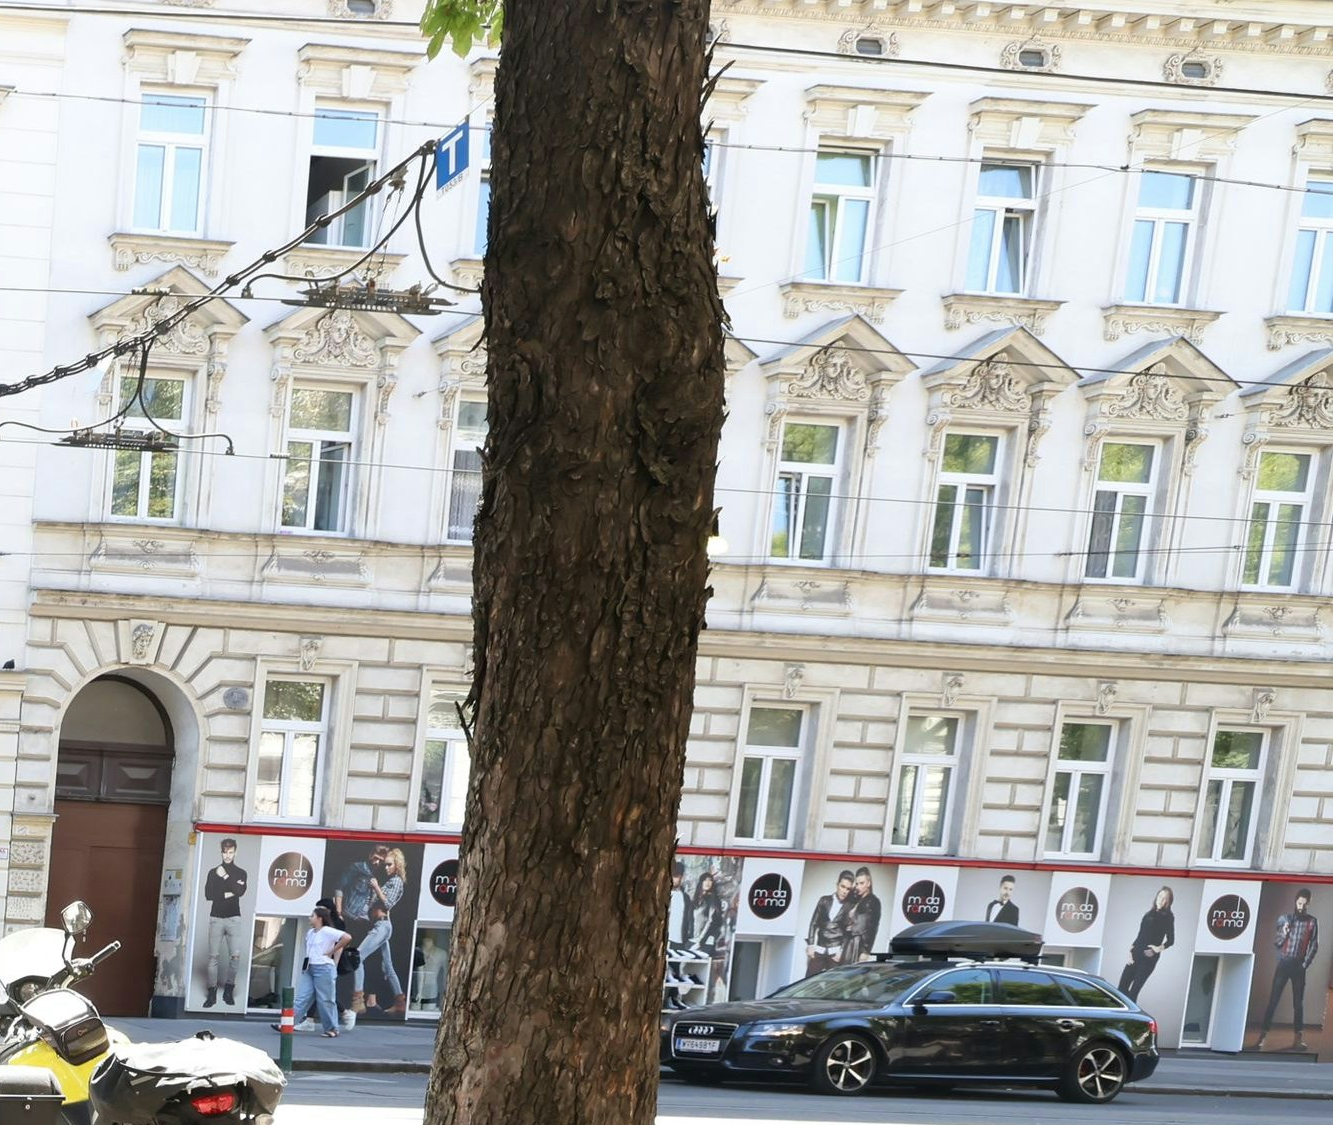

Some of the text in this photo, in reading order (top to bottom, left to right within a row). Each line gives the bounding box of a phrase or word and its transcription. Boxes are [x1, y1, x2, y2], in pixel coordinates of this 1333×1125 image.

[273, 877, 306, 887] roma
[752, 897, 786, 907] roma
[906, 904, 939, 914] roma
[1060, 911, 1092, 921] roma
[1212, 918, 1243, 928] roma
